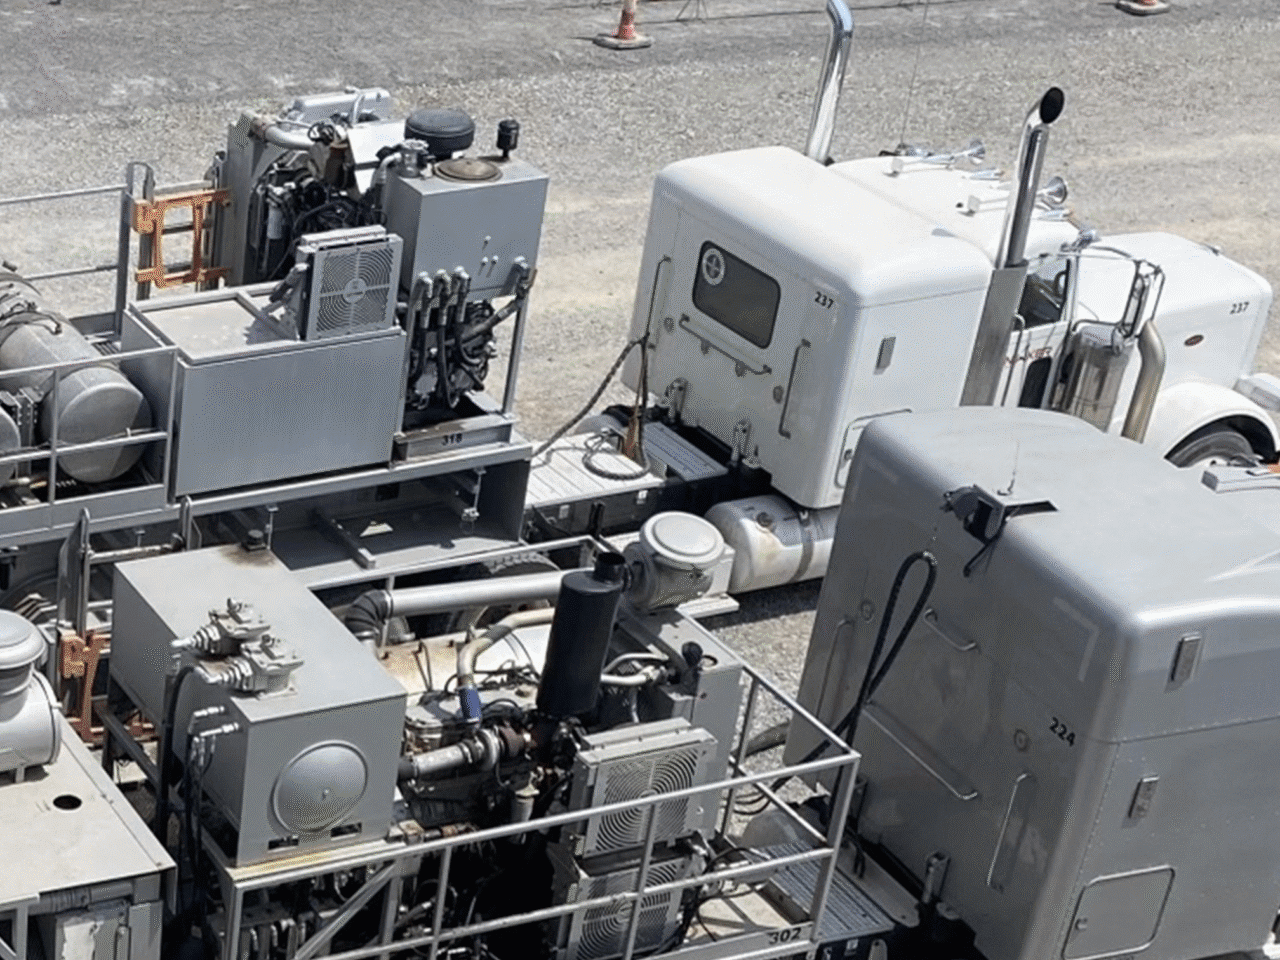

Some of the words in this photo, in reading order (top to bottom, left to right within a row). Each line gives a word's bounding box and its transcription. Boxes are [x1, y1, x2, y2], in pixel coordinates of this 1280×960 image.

[814, 291, 835, 310] 237
[1229, 301, 1250, 315] 237
[1049, 716, 1076, 747] 224
[766, 927, 802, 945] 302
